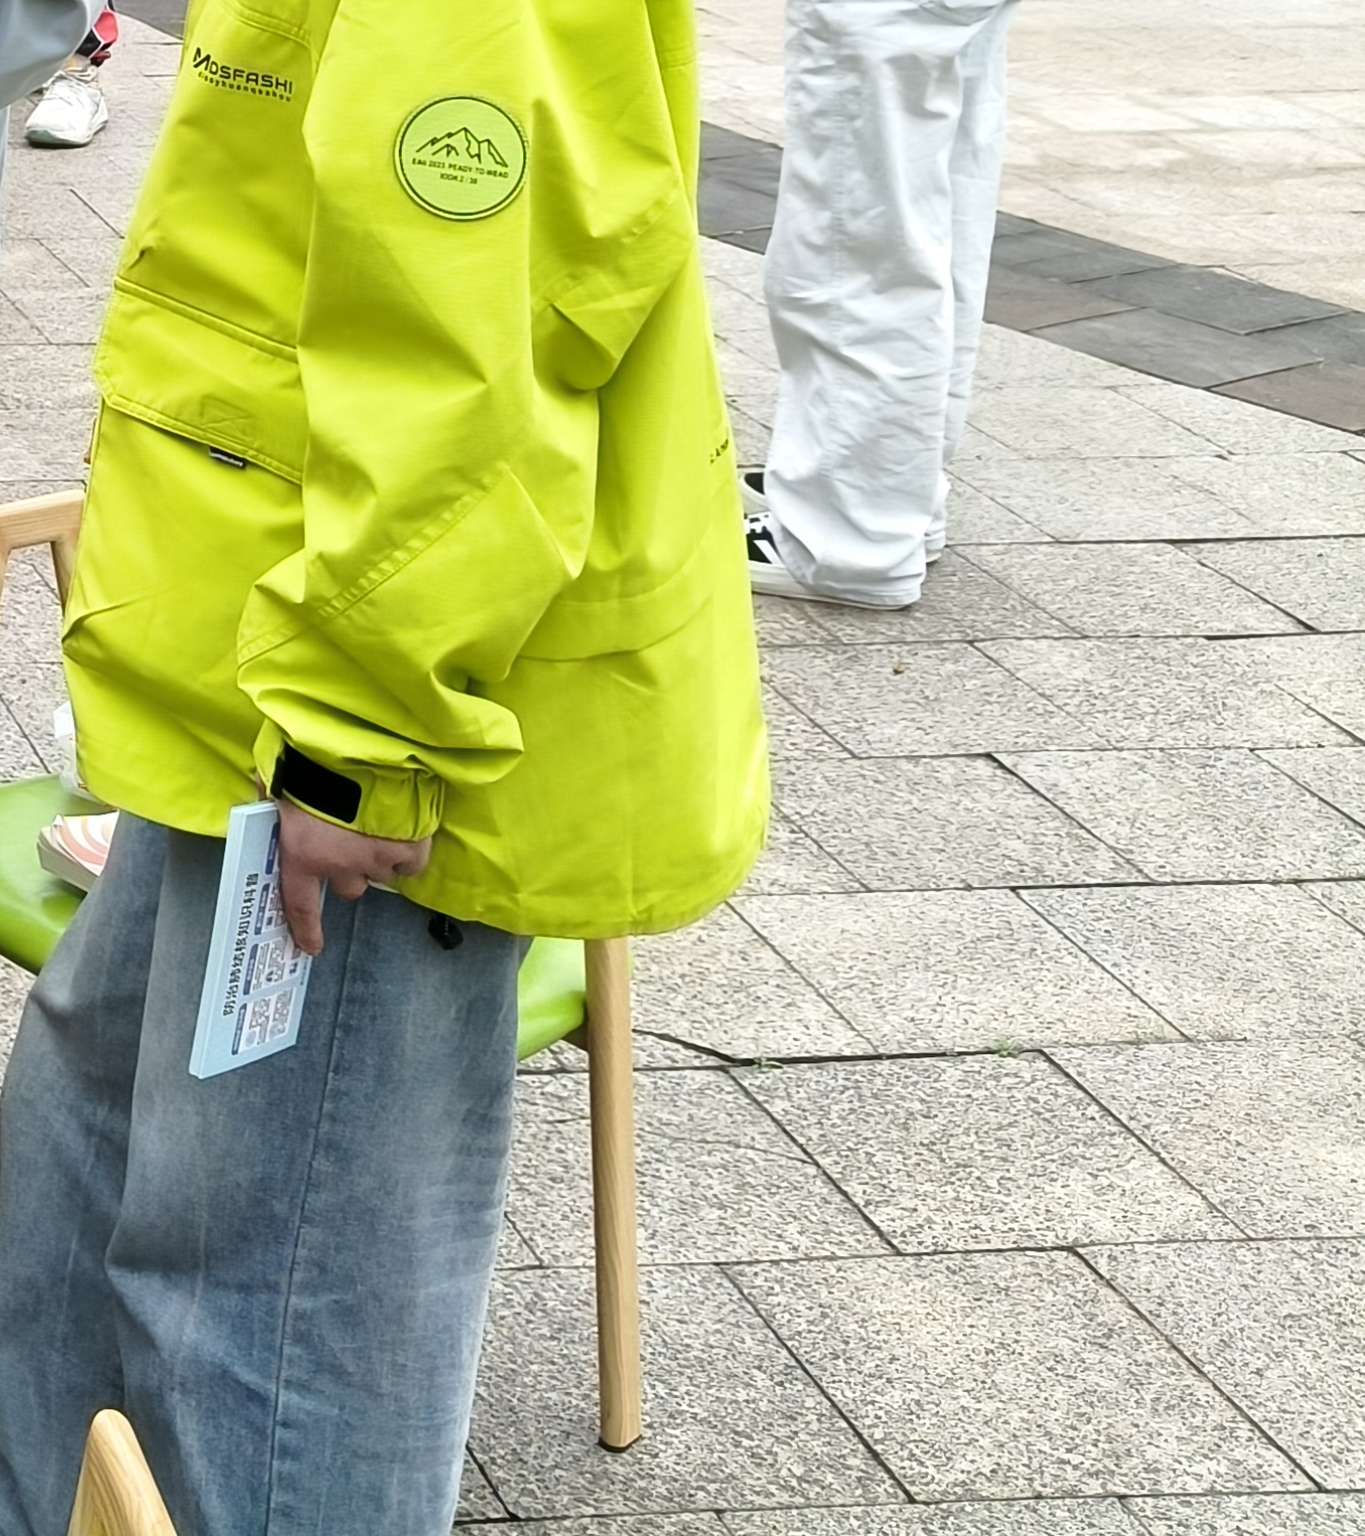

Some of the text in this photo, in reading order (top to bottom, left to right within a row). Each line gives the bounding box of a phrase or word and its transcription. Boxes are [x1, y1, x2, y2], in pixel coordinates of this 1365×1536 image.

[223, 872, 258, 1016] 防治肺结核知识科普
